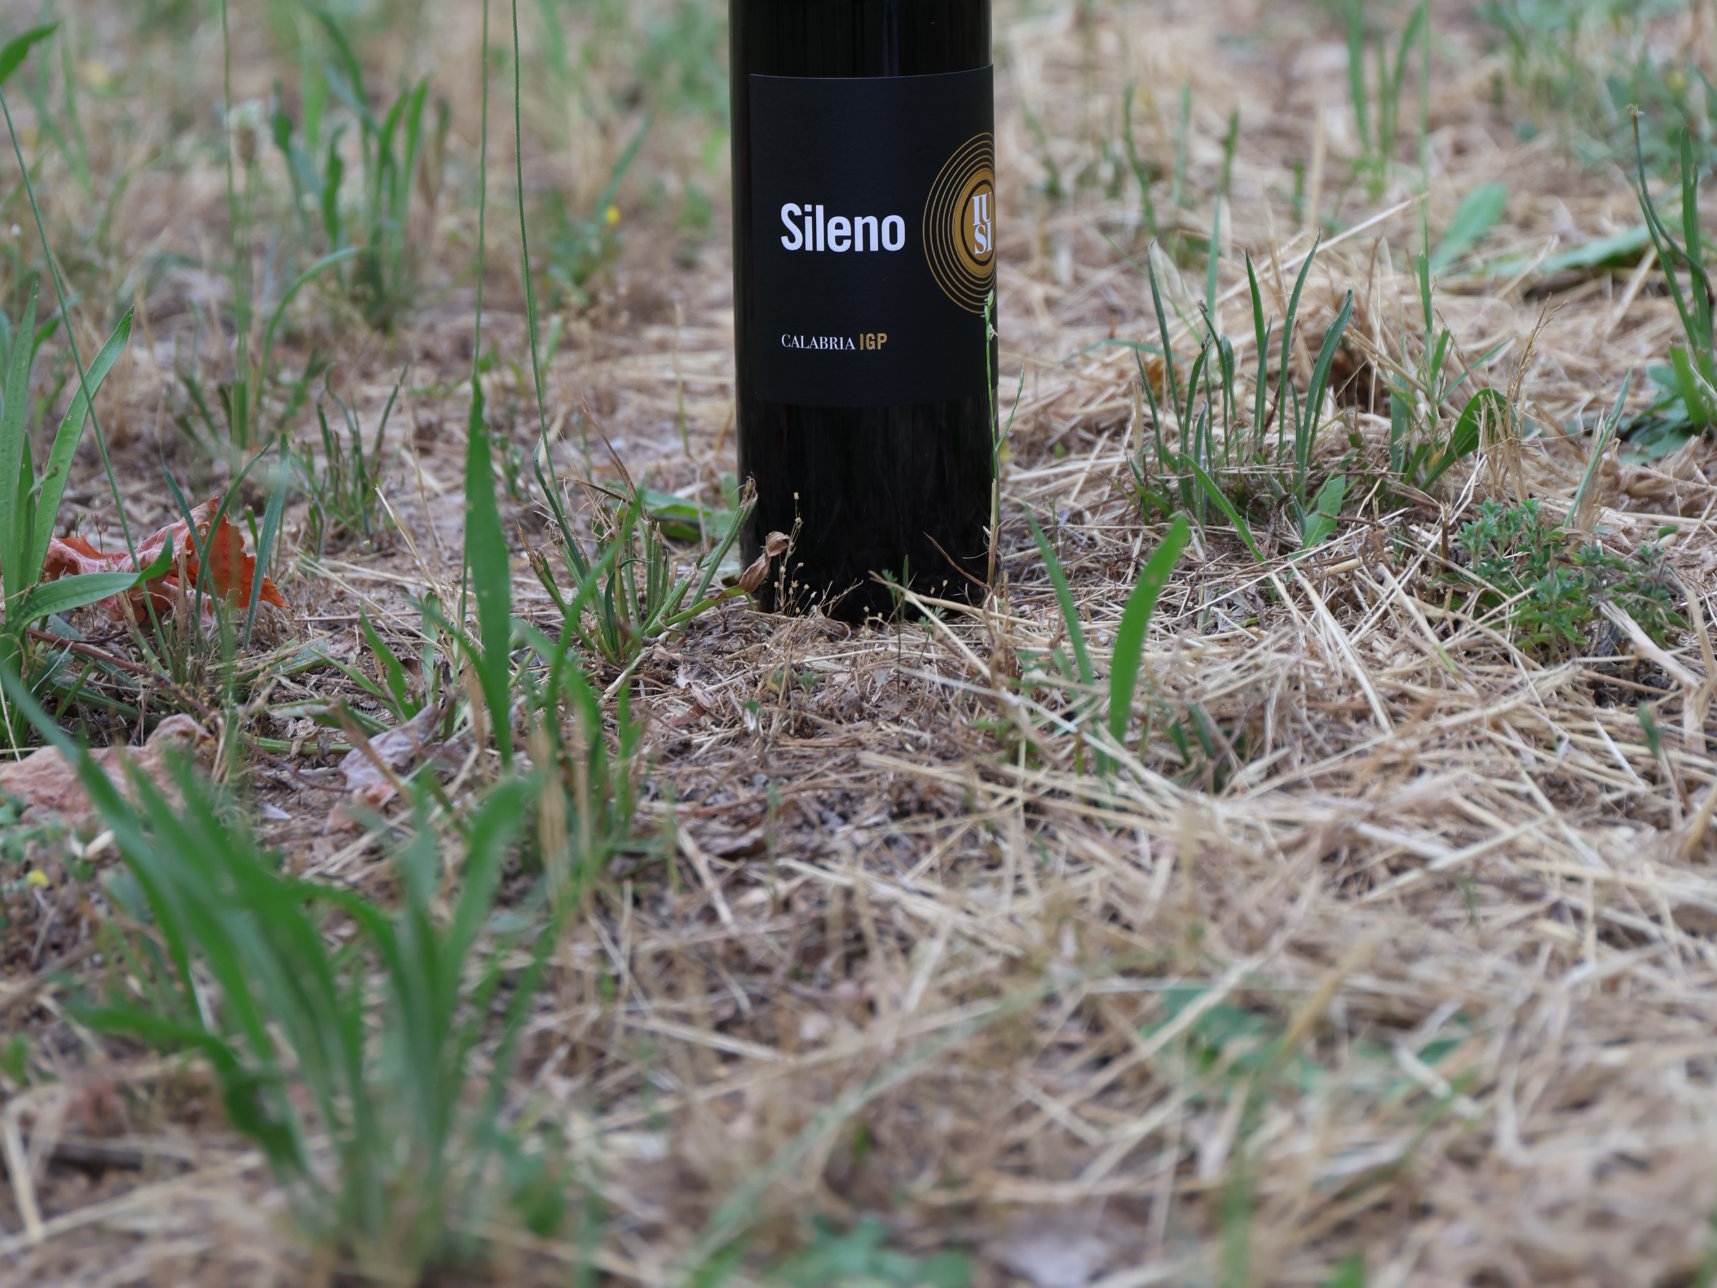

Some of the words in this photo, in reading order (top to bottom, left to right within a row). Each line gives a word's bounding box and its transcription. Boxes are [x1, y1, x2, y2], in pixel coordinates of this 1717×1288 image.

[780, 202, 906, 252] Sileno
[781, 333, 856, 350] CALABRIA
[859, 332, 888, 351] IGP
